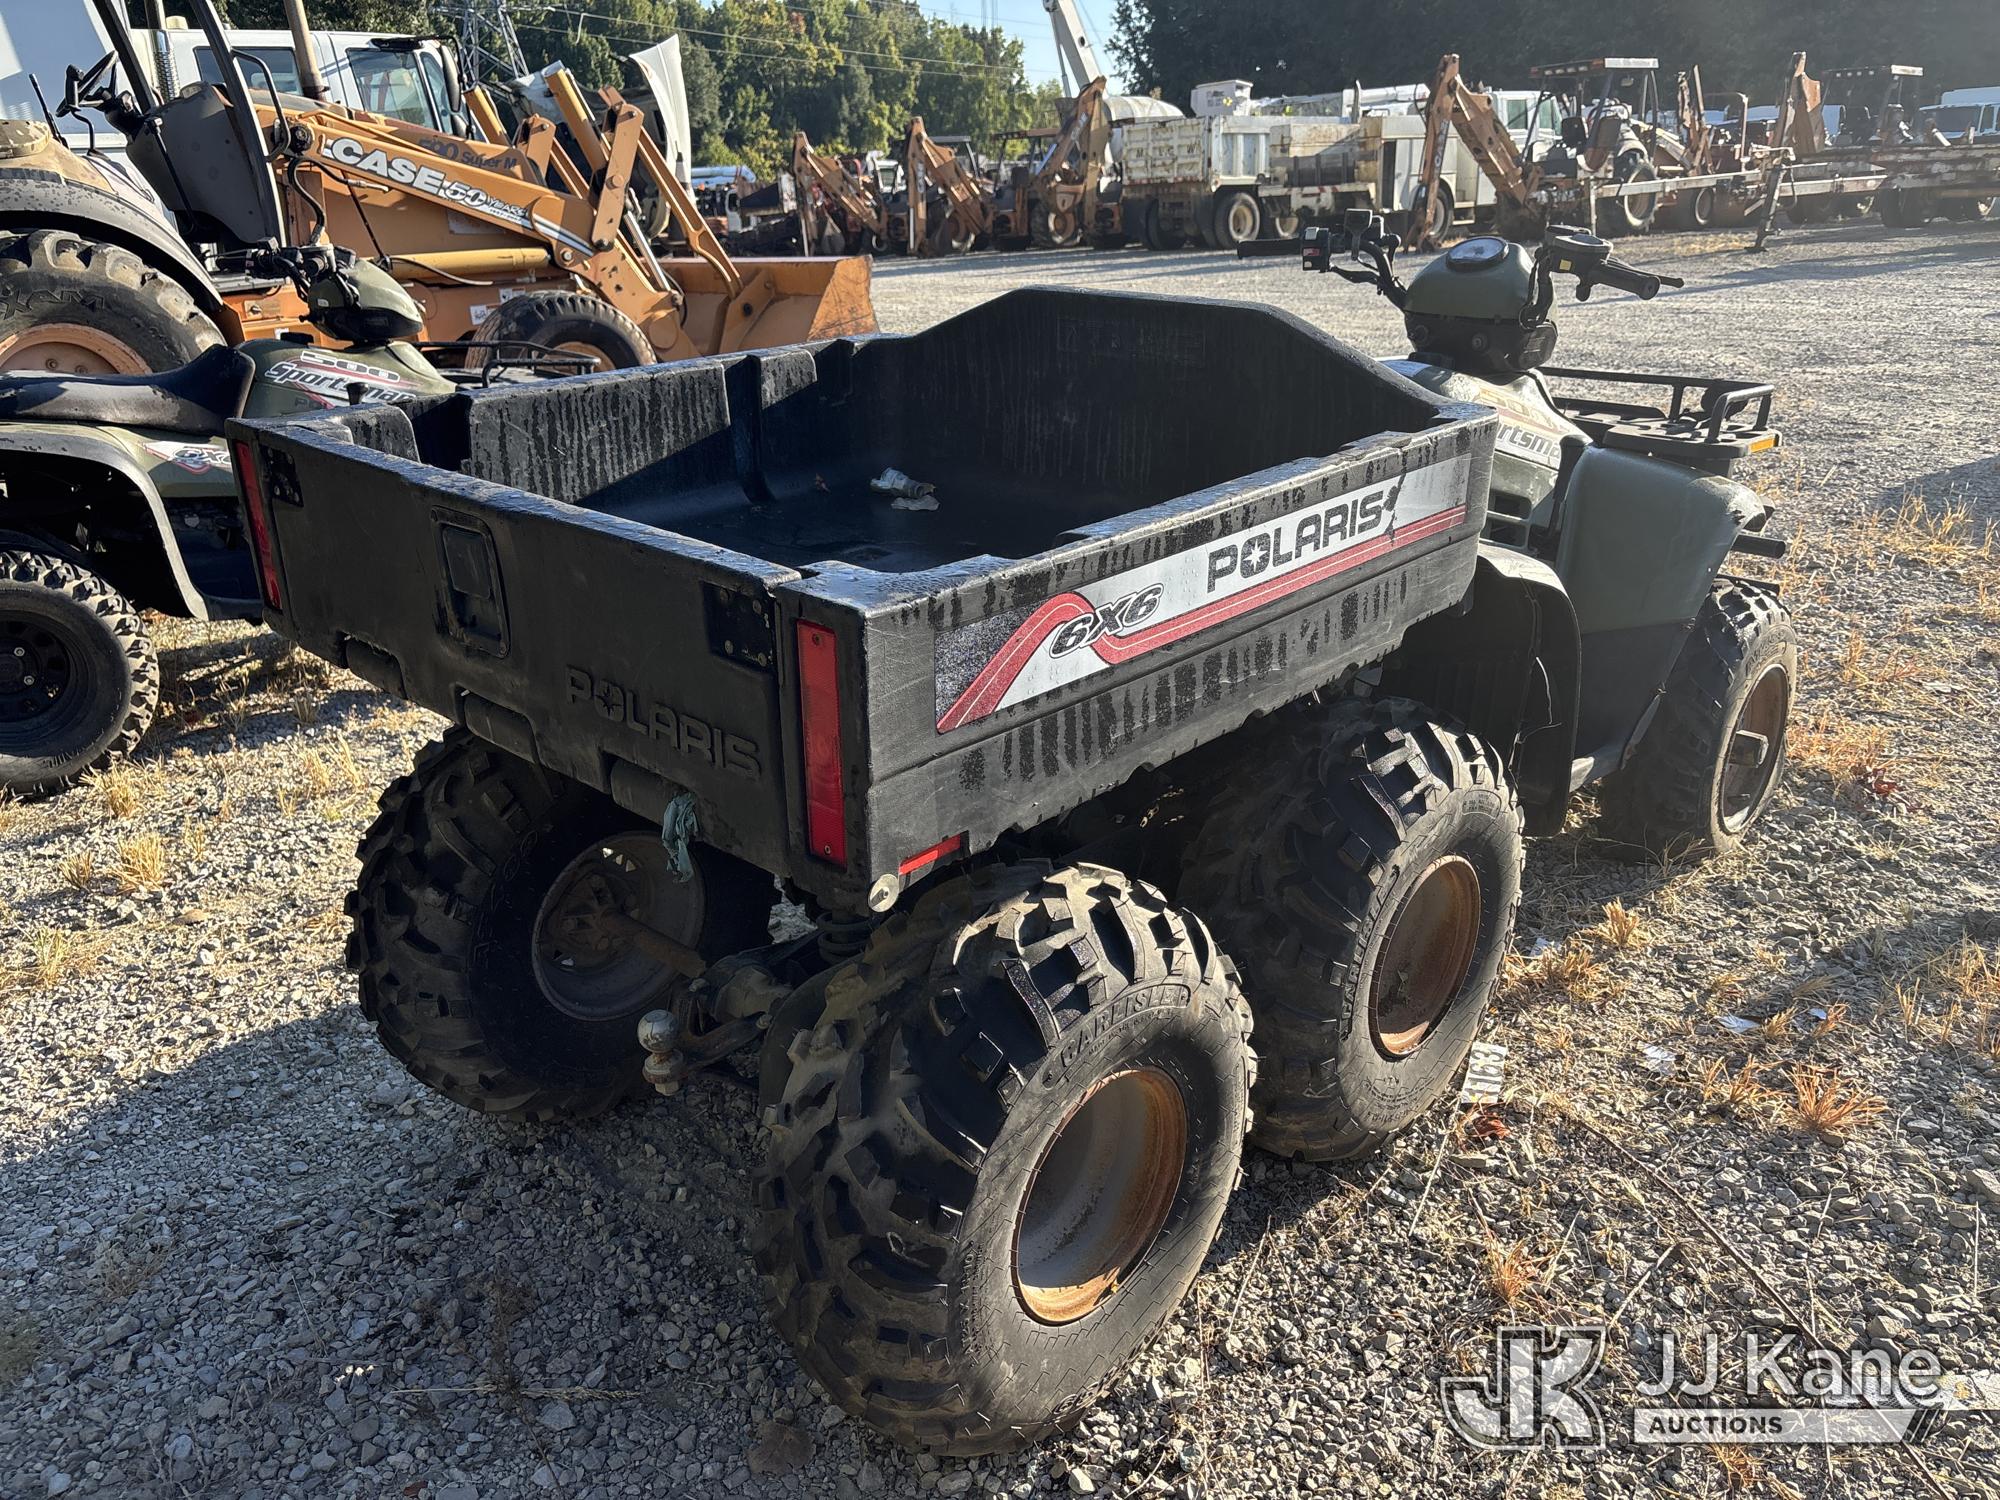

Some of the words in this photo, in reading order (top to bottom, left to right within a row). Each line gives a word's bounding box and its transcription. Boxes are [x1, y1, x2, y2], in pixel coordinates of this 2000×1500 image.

[331, 137, 446, 195] CASE
[444, 181, 488, 207] 50
[461, 151, 499, 168] Super
[503, 156, 517, 169] M
[1207, 490, 1384, 594] POLARIS
[566, 664, 763, 780] POLARIS
